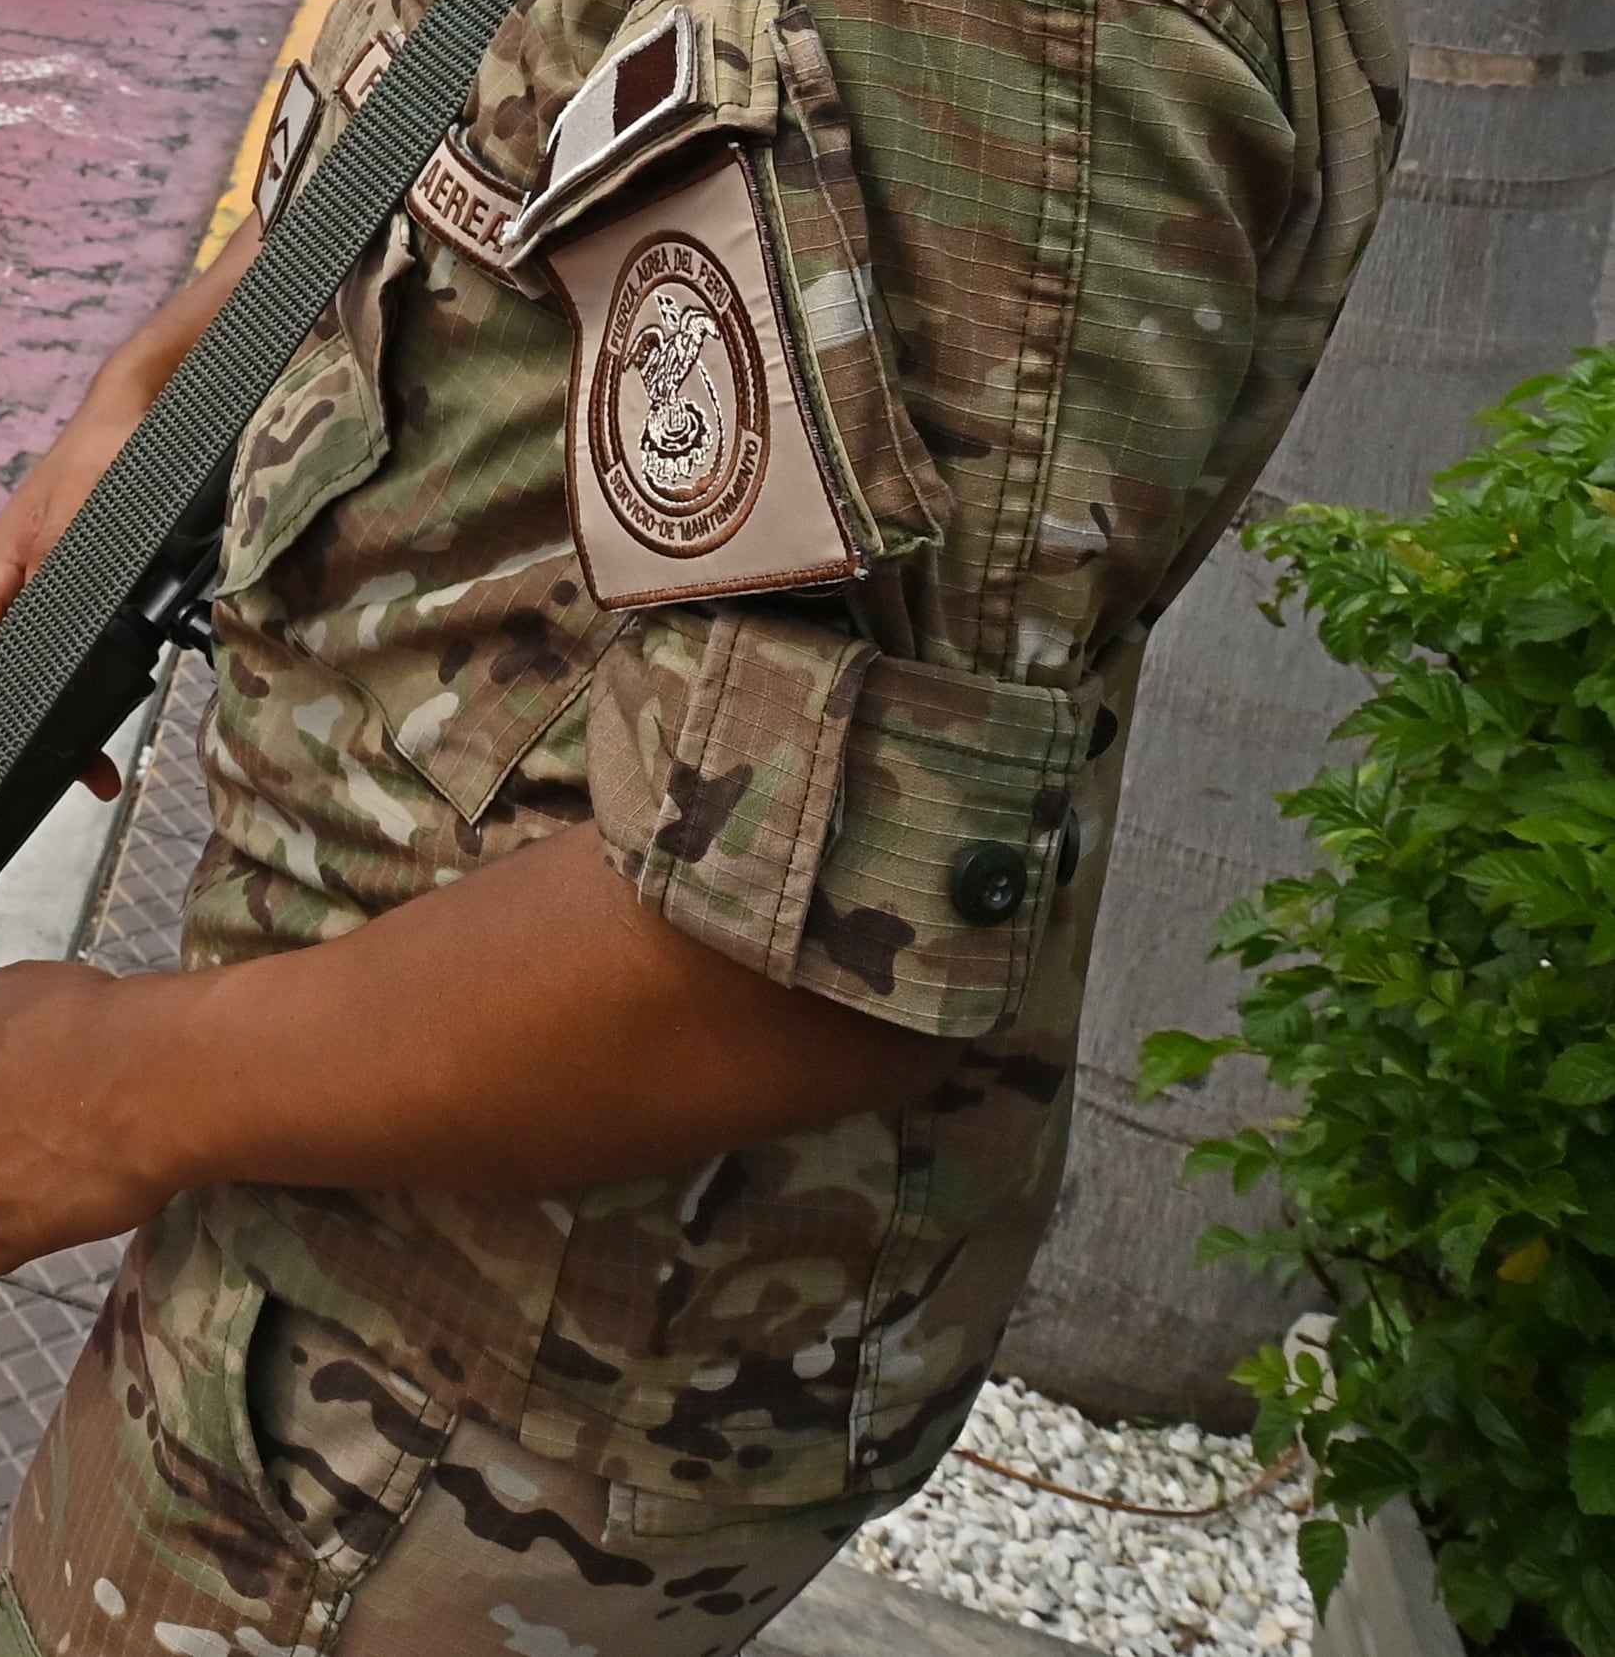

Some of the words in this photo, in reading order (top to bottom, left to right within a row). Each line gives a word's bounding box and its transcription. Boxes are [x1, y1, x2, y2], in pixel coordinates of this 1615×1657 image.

[418, 157, 512, 254] AEREA
[610, 281, 640, 350] FUERZA
[636, 246, 671, 286] AEREA
[673, 247, 695, 276] DEL
[698, 262, 733, 310] PERU
[609, 469, 657, 532] SERVICIO
[658, 520, 676, 541] DE
